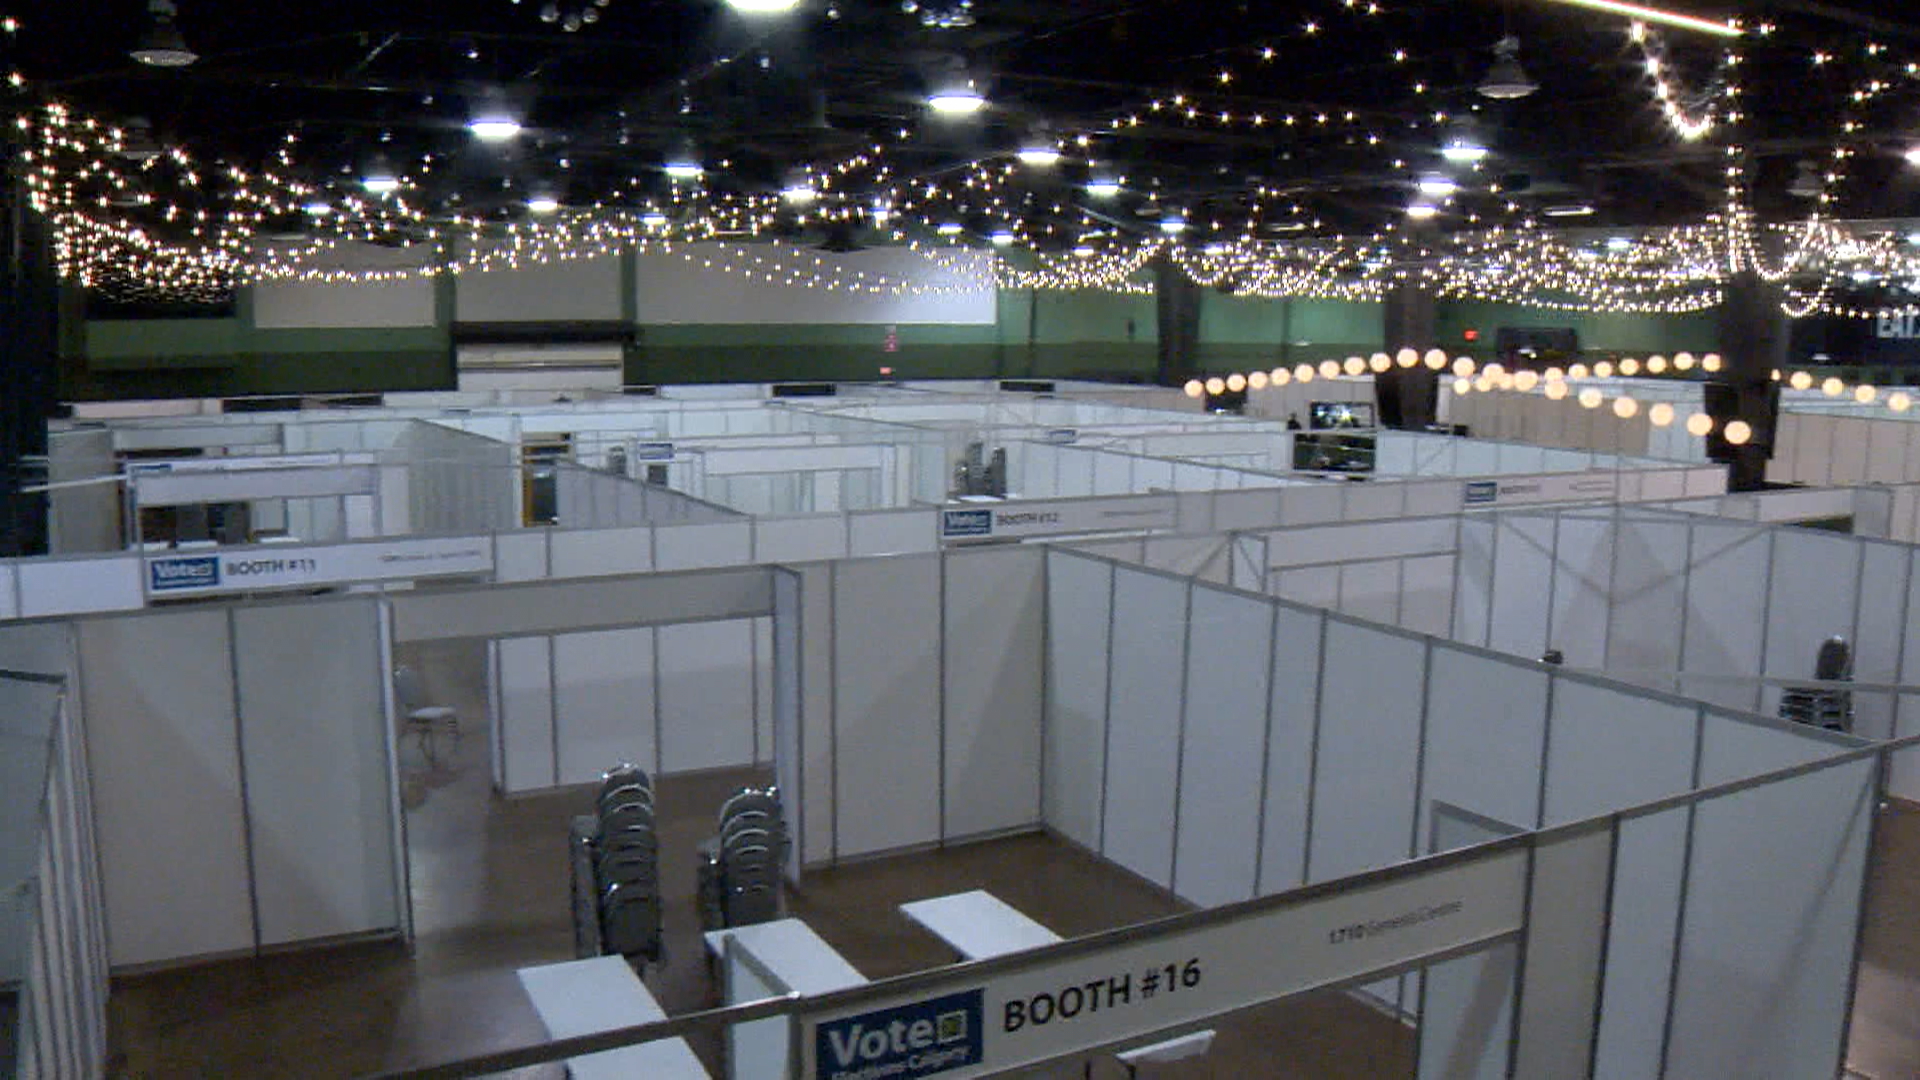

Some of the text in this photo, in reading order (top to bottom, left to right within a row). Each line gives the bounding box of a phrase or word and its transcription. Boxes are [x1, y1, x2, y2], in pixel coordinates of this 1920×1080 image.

[226, 559, 284, 576] BOOTH
[1003, 957, 1202, 1033] BOOTH #16
[828, 1017, 935, 1067] Vote
